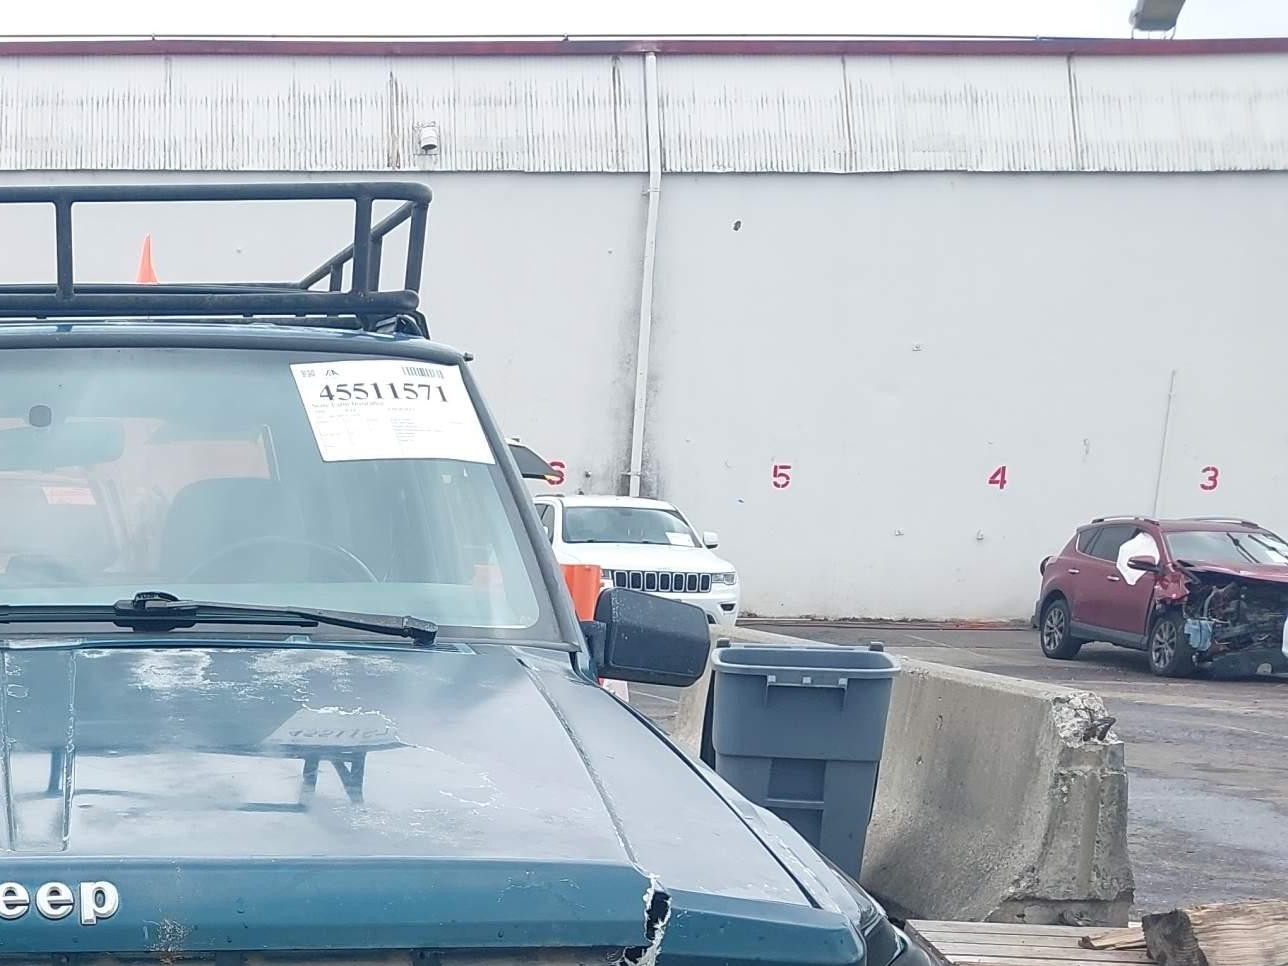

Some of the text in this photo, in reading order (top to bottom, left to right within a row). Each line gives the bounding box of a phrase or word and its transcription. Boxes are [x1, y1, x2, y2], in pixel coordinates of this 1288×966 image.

[319, 382, 448, 402] 45511571
[773, 465, 792, 488] 5
[988, 466, 1008, 489] 4
[1200, 467, 1219, 491] 3
